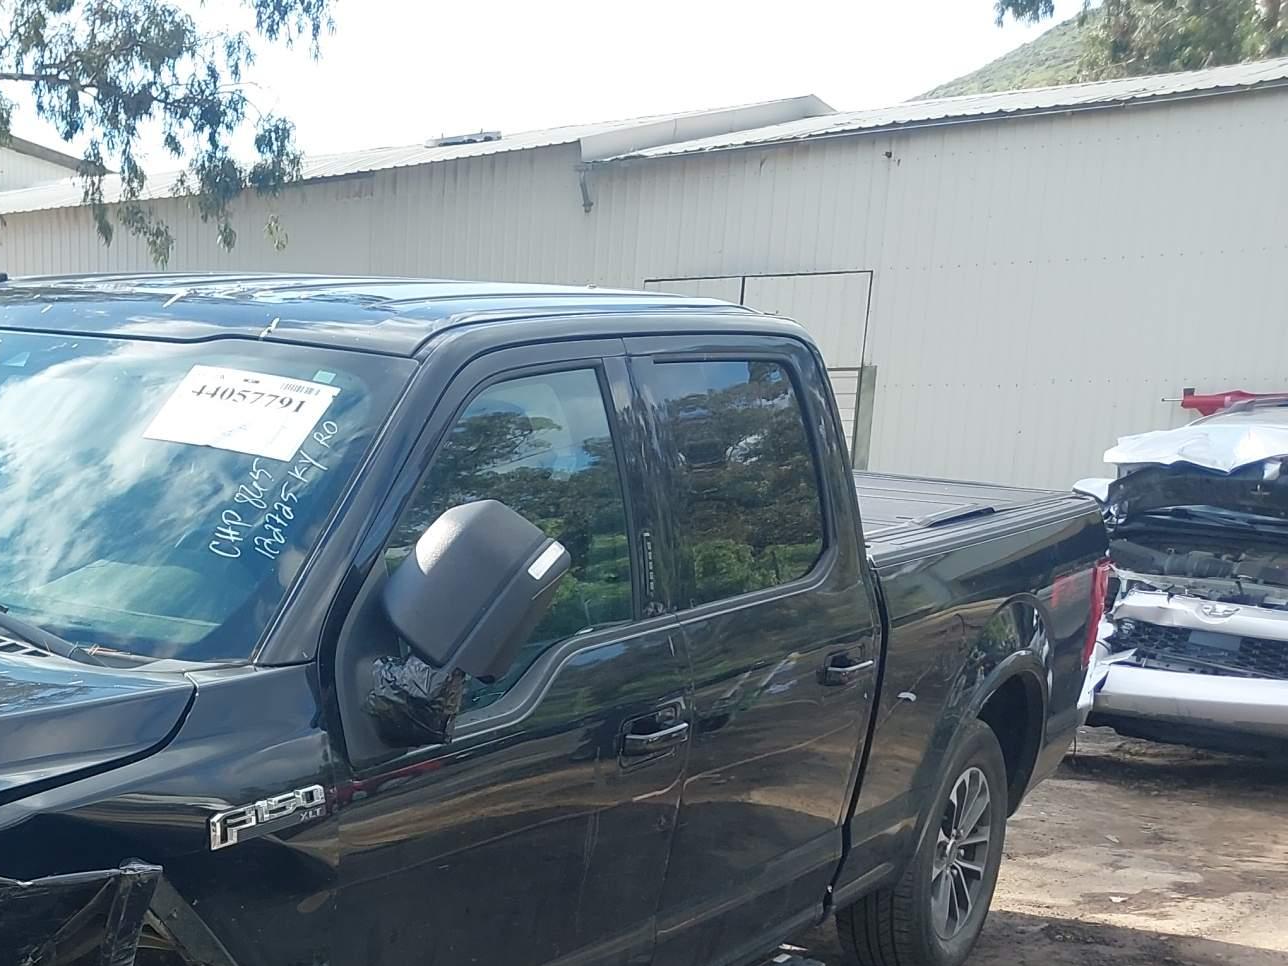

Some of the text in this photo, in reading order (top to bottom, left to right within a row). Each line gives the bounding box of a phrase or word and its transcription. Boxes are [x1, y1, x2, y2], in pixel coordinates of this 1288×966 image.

[192, 384, 306, 413] 44057791
[209, 510, 253, 559] CHP
[300, 808, 322, 821] XLT
